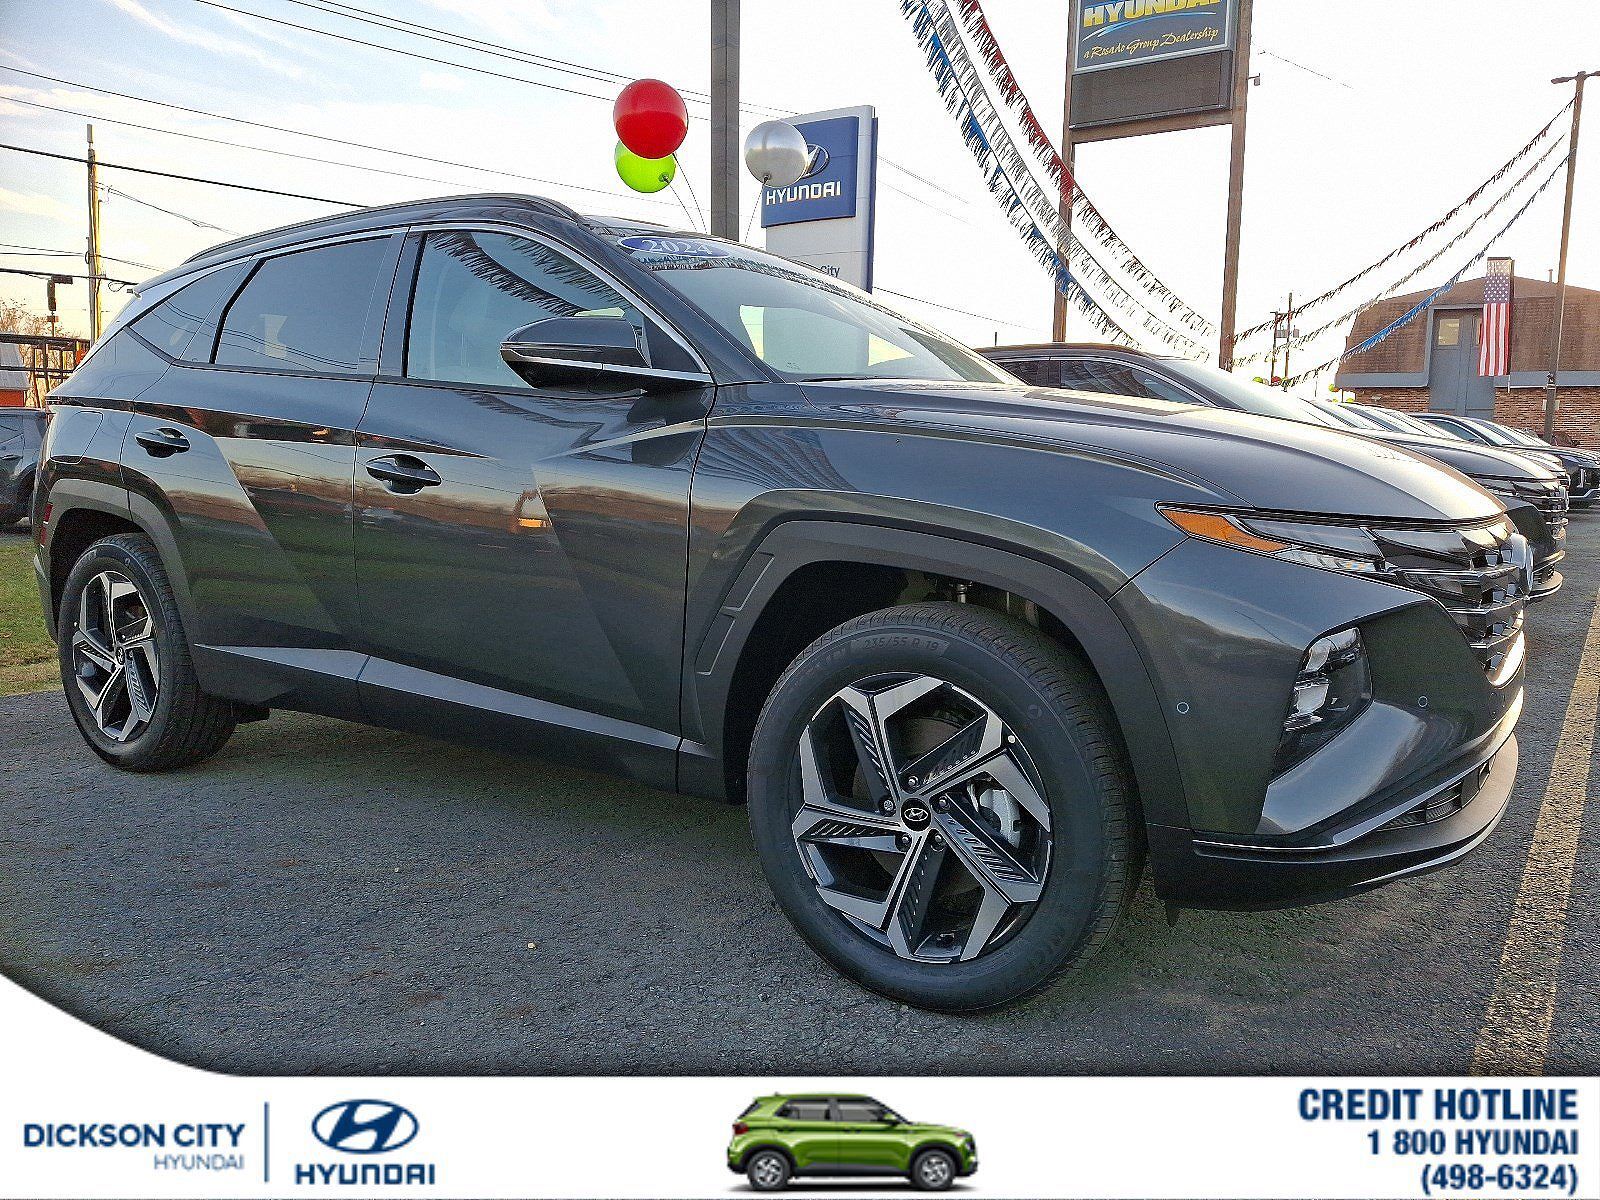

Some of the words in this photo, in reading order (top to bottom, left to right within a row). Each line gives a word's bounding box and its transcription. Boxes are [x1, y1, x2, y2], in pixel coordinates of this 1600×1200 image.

[1083, 0, 1221, 27] HYUND
[1091, 44, 1126, 59] Rosado
[1126, 39, 1160, 55] Group
[1160, 27, 1218, 47] Dealership
[765, 180, 841, 205] HYUNDAI
[641, 239, 713, 255] 2024
[820, 264, 841, 278] City
